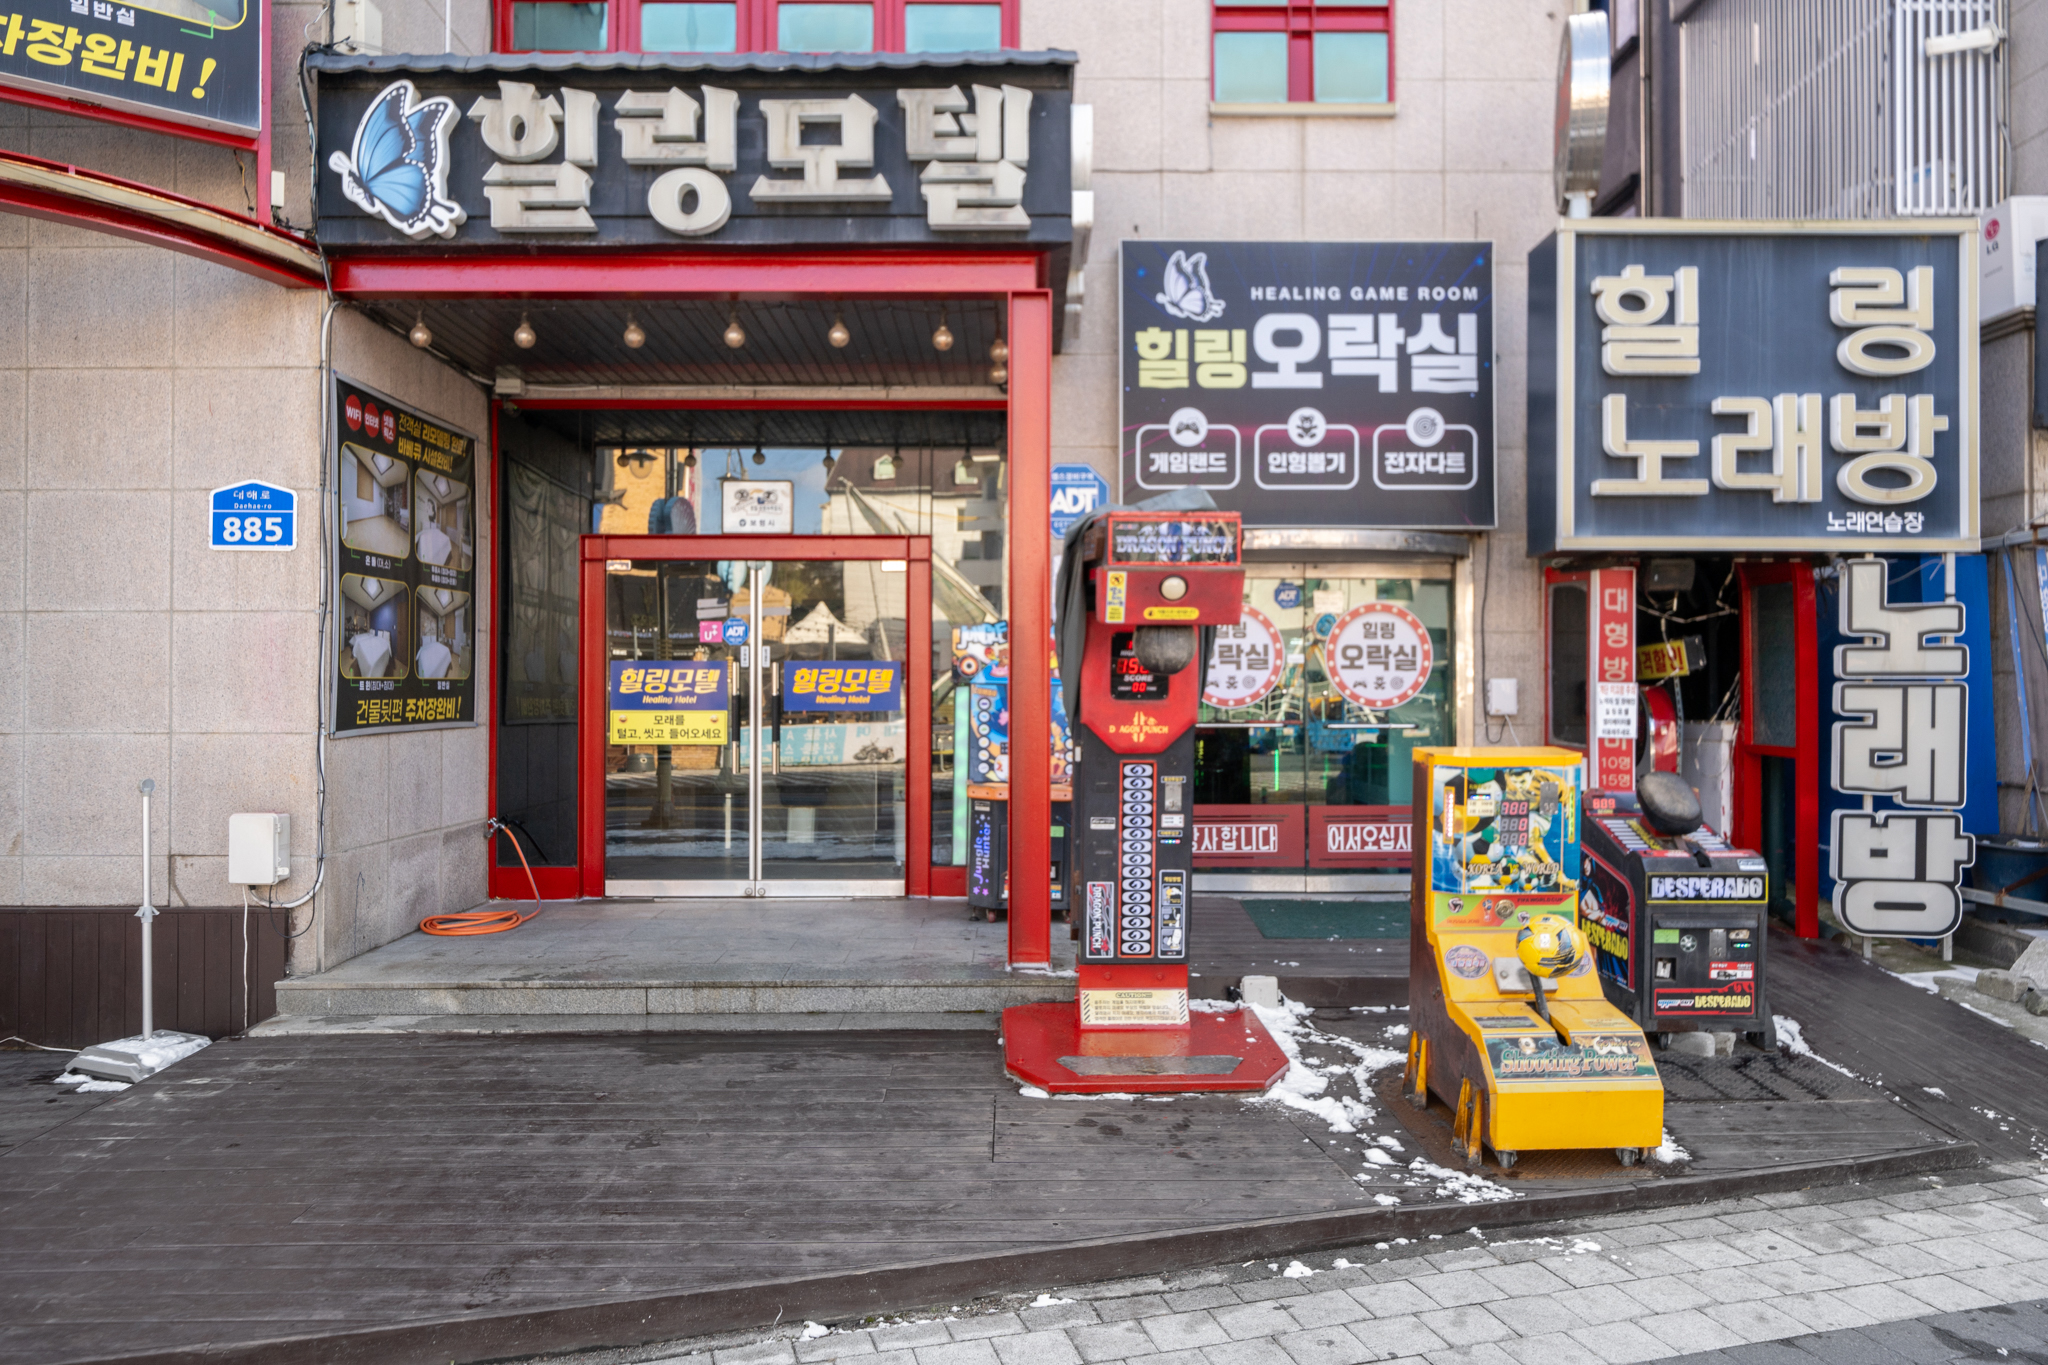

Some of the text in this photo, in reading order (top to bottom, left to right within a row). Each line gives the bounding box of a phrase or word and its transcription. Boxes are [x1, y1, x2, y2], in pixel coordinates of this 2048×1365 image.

[468, 80, 1031, 235] 힐링모텔
[1250, 287, 1478, 300] HEALING GAME ROOM
[347, 405, 362, 422] WIFI
[1591, 393, 1949, 504] 노래방
[1150, 452, 1228, 474] 게임랜드
[1268, 452, 1346, 474] 인형뽑기
[1385, 452, 1466, 474] 전자다트
[233, 490, 270, 500] 대해로
[1050, 487, 1098, 514] ADT
[223, 517, 283, 542] 885
[1826, 511, 1924, 534] 노래연습장
[1116, 535, 1234, 553] DRAGON PUNCH
[1278, 590, 1297, 601] ADT
[726, 626, 746, 637] ADT
[1362, 622, 1395, 639] 힐링
[1208, 644, 1269, 671] 락실
[1341, 644, 1417, 671] 오락실
[619, 668, 720, 694] 힐링모텔
[793, 668, 893, 694] 힐링모텔
[1124, 674, 1153, 682] SCORE
[357, 696, 461, 725] 건물뒷편 주차장완비!
[642, 694, 697, 705] Healing Motel
[815, 694, 870, 705] Healing Motel
[653, 715, 685, 726] 모래를
[1142, 725, 1168, 734] PUNCH
[617, 729, 721, 740] 털고, 씻고 들어오세요
[1830, 558, 1976, 938] 노래방
[1501, 801, 1528, 815] 700
[982, 822, 991, 868] Hunter
[973, 837, 984, 884] Jungle
[1467, 862, 1560, 875] KOREA VS WORLD
[1651, 877, 1763, 899] DESPERADO
[1092, 886, 1102, 950] DRAGON PUNCH
[1581, 917, 1629, 960] DESPERADO
[1695, 995, 1751, 1008] DESPERADO
[1501, 1047, 1639, 1075] Shooting Power
